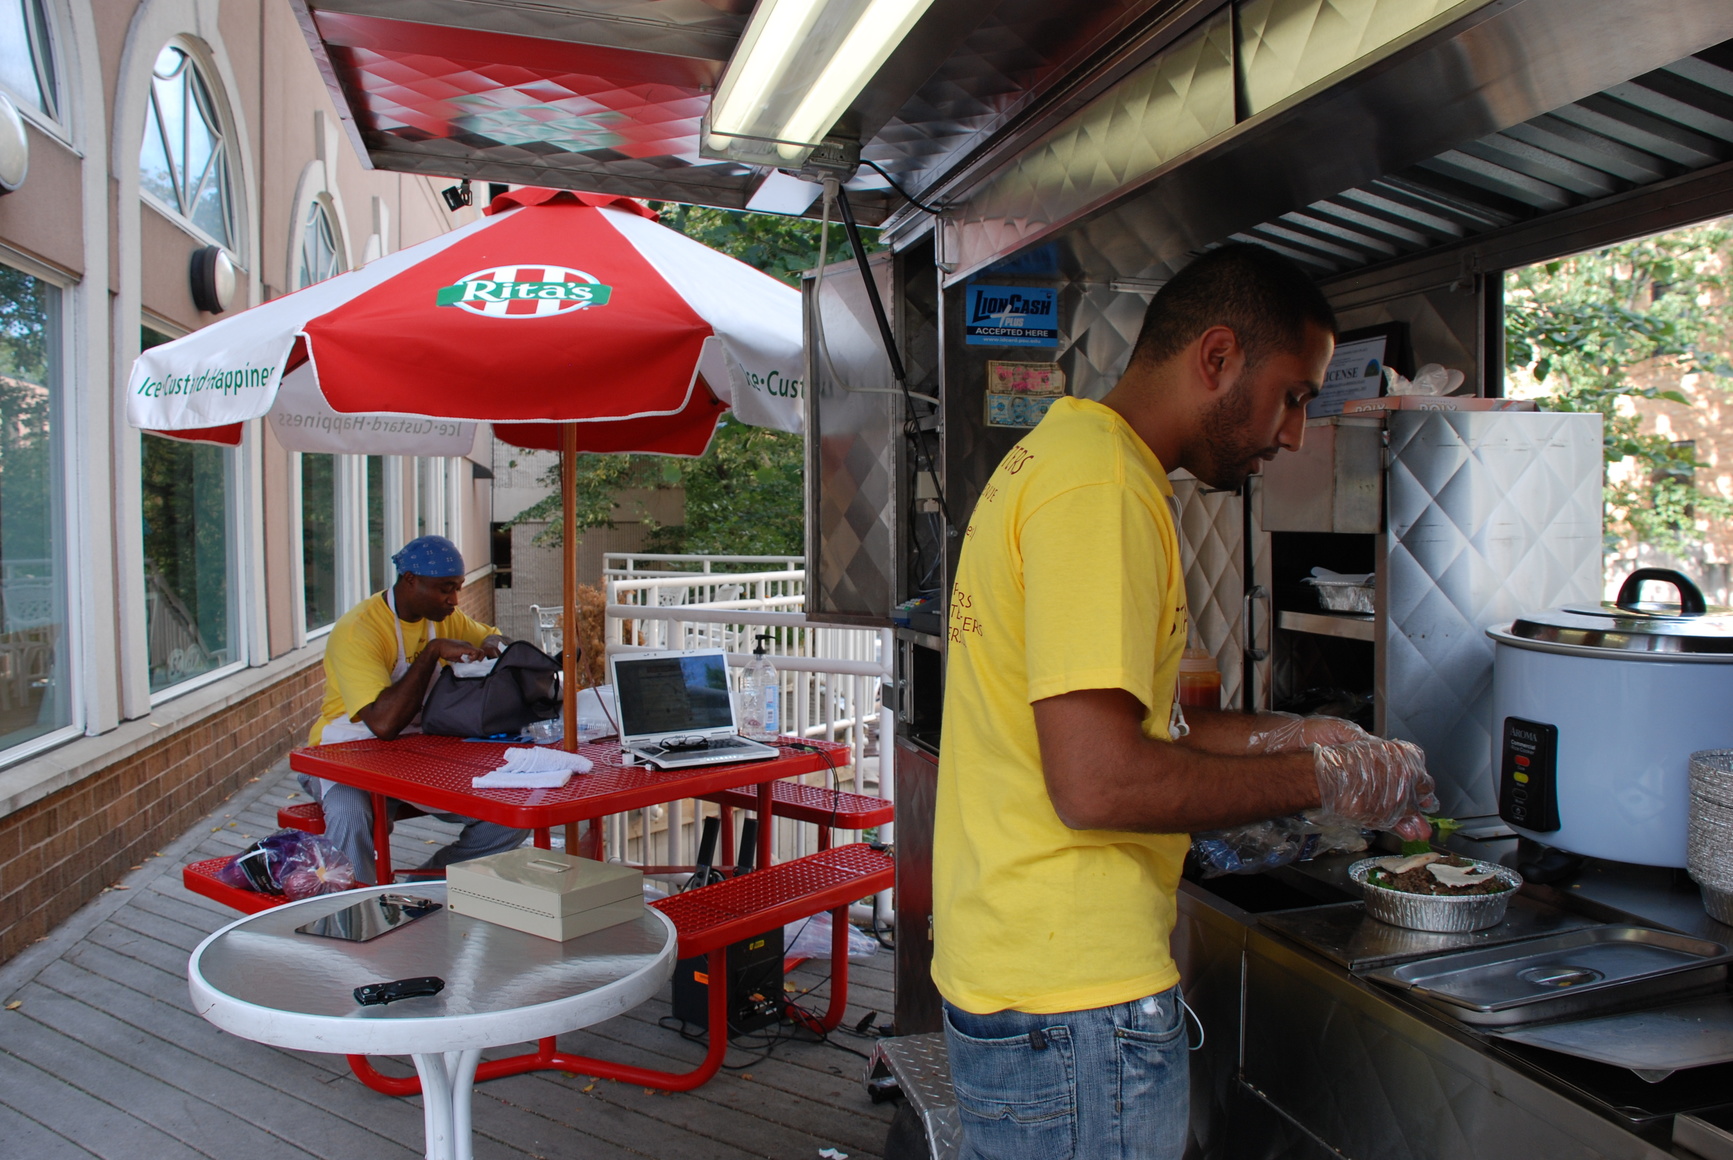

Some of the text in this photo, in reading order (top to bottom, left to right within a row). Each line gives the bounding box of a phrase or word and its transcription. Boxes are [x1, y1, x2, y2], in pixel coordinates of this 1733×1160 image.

[461, 280, 594, 303] Rita's
[1005, 317, 1024, 327] PLUS
[975, 327, 1049, 337] ACCEPTED HERE
[1325, 367, 1359, 382] ICENSE
[1510, 727, 1537, 742] AROMA
